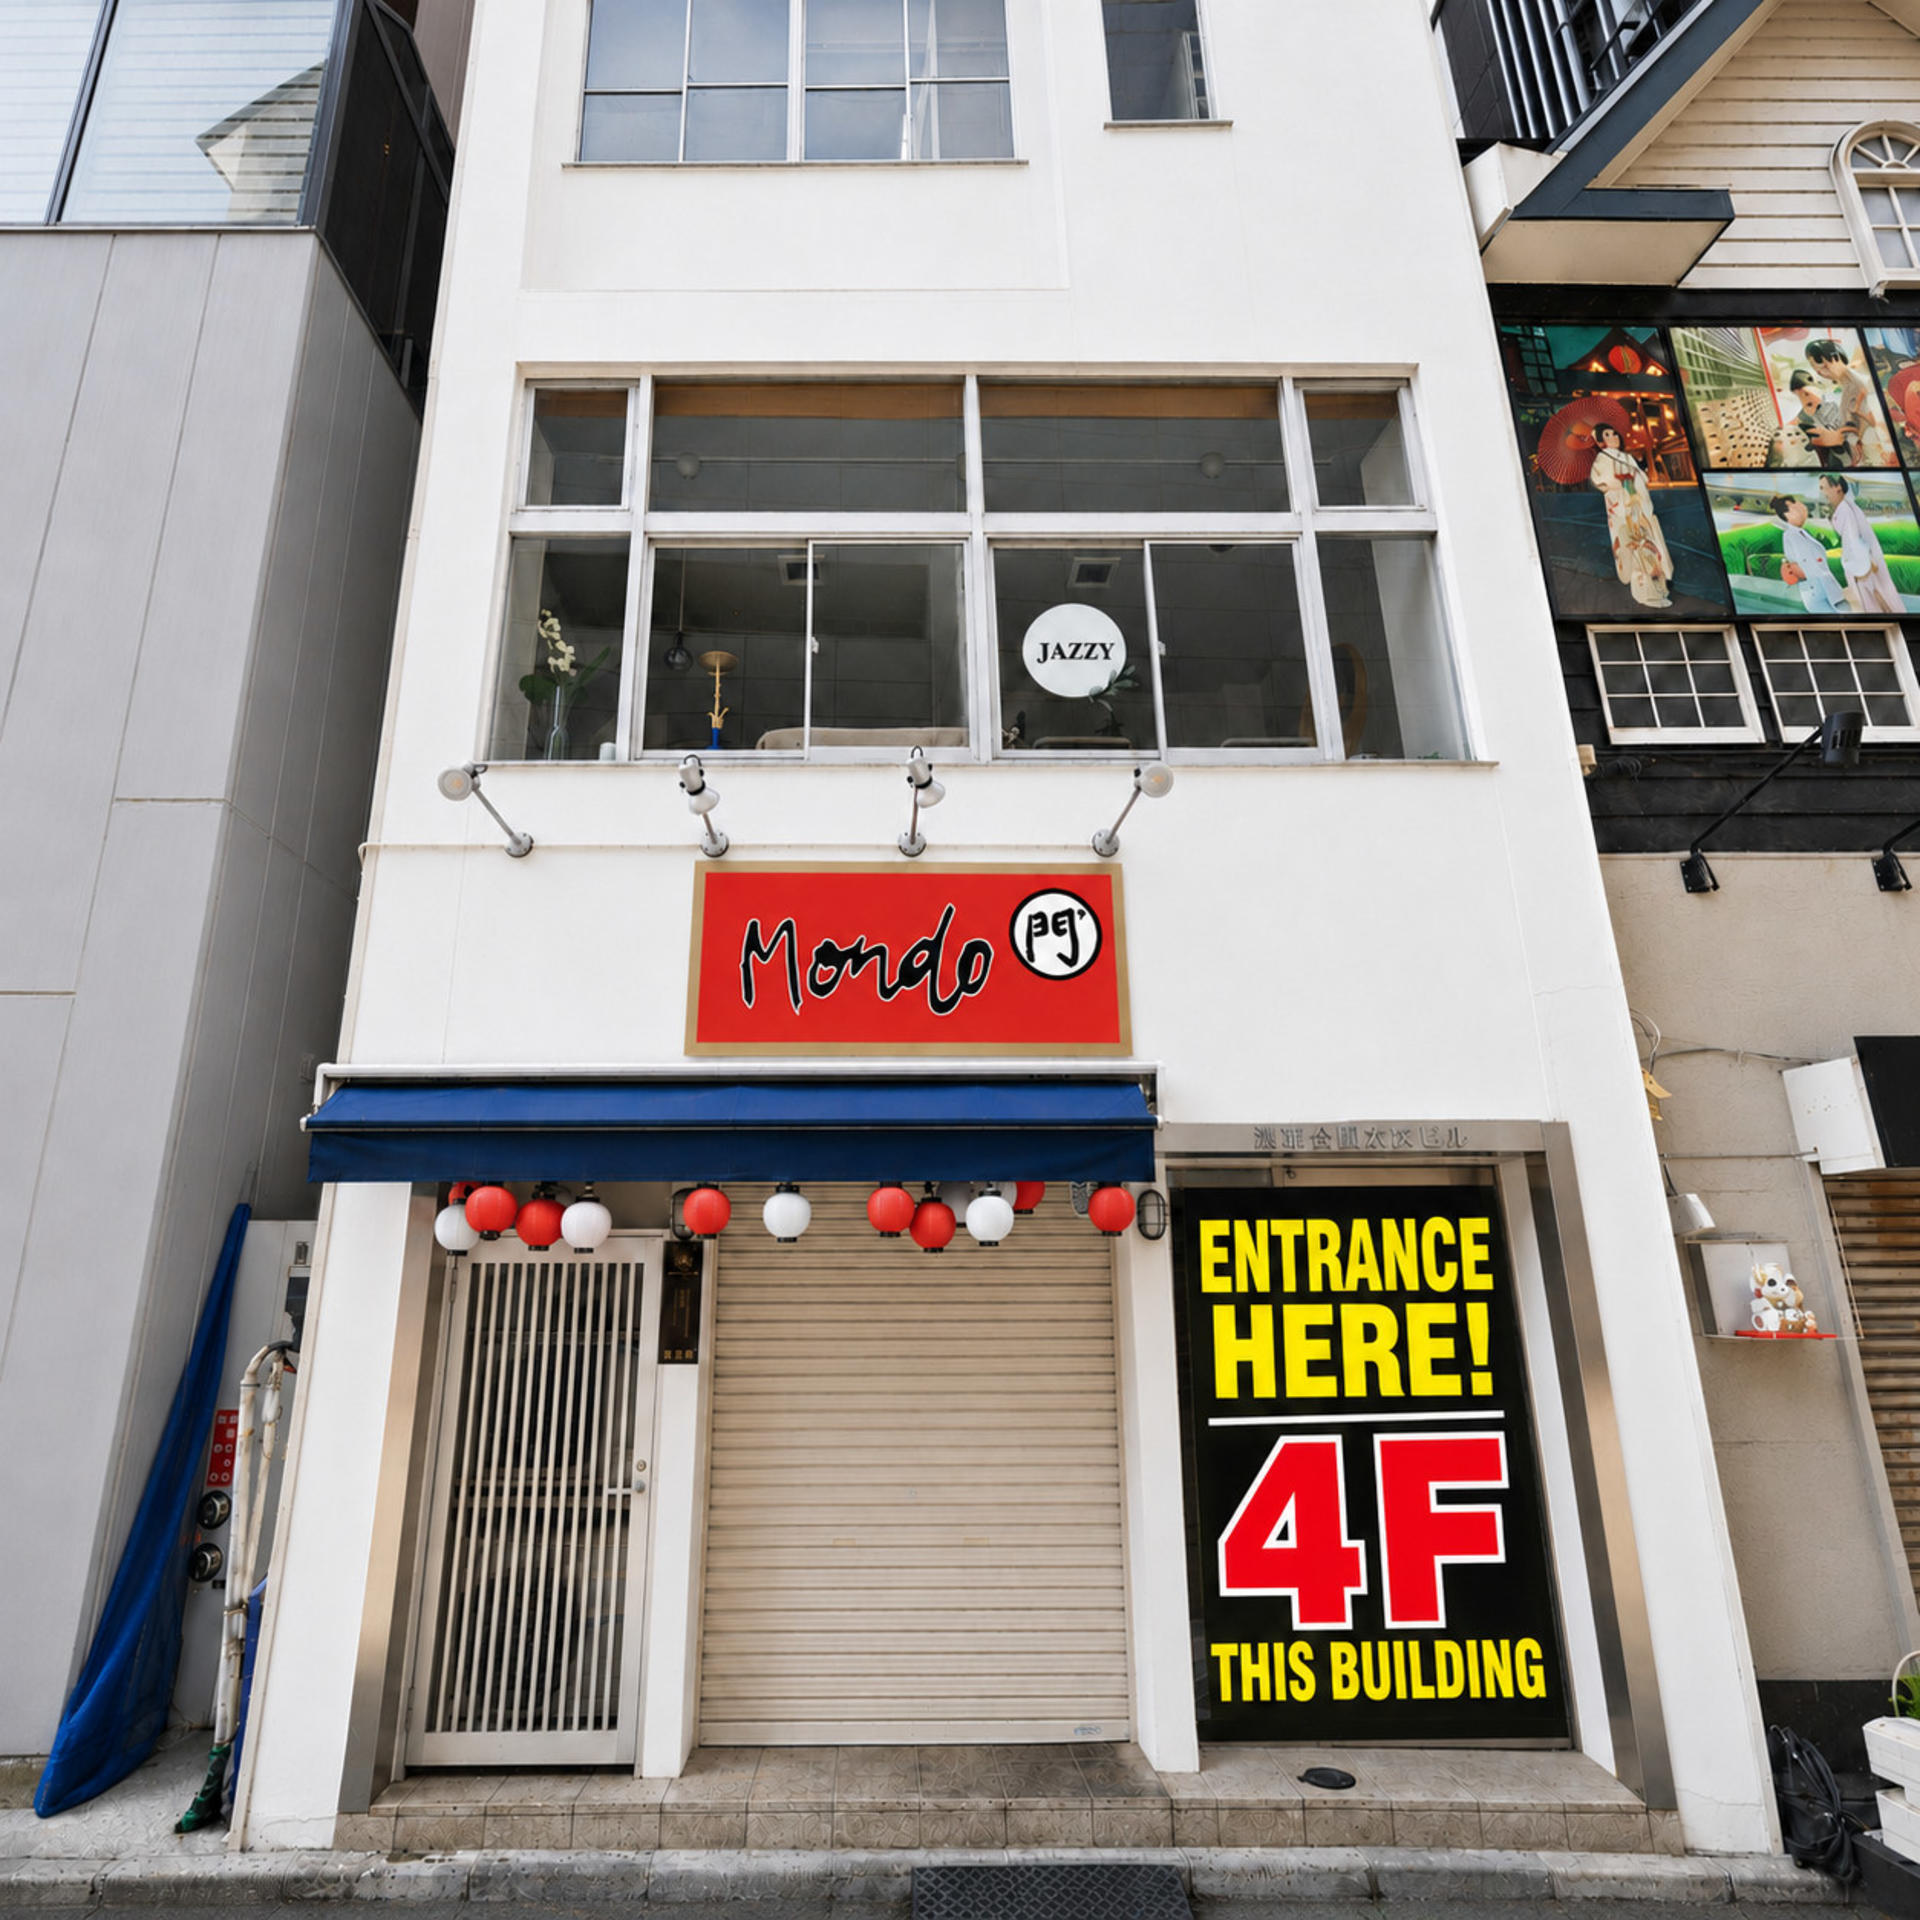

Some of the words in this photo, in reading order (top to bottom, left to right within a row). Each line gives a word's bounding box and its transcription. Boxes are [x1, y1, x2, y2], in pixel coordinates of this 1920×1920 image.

[1037, 643, 1114, 665] JAZZY
[739, 903, 994, 1017] Mondo
[1199, 1217, 1494, 1293] ENTRANCE
[1212, 1302, 1494, 1399] HERE!
[1217, 1431, 1509, 1631] 4F
[1210, 1640, 1316, 1702] THIS
[1330, 1638, 1547, 1702] BUILDING
